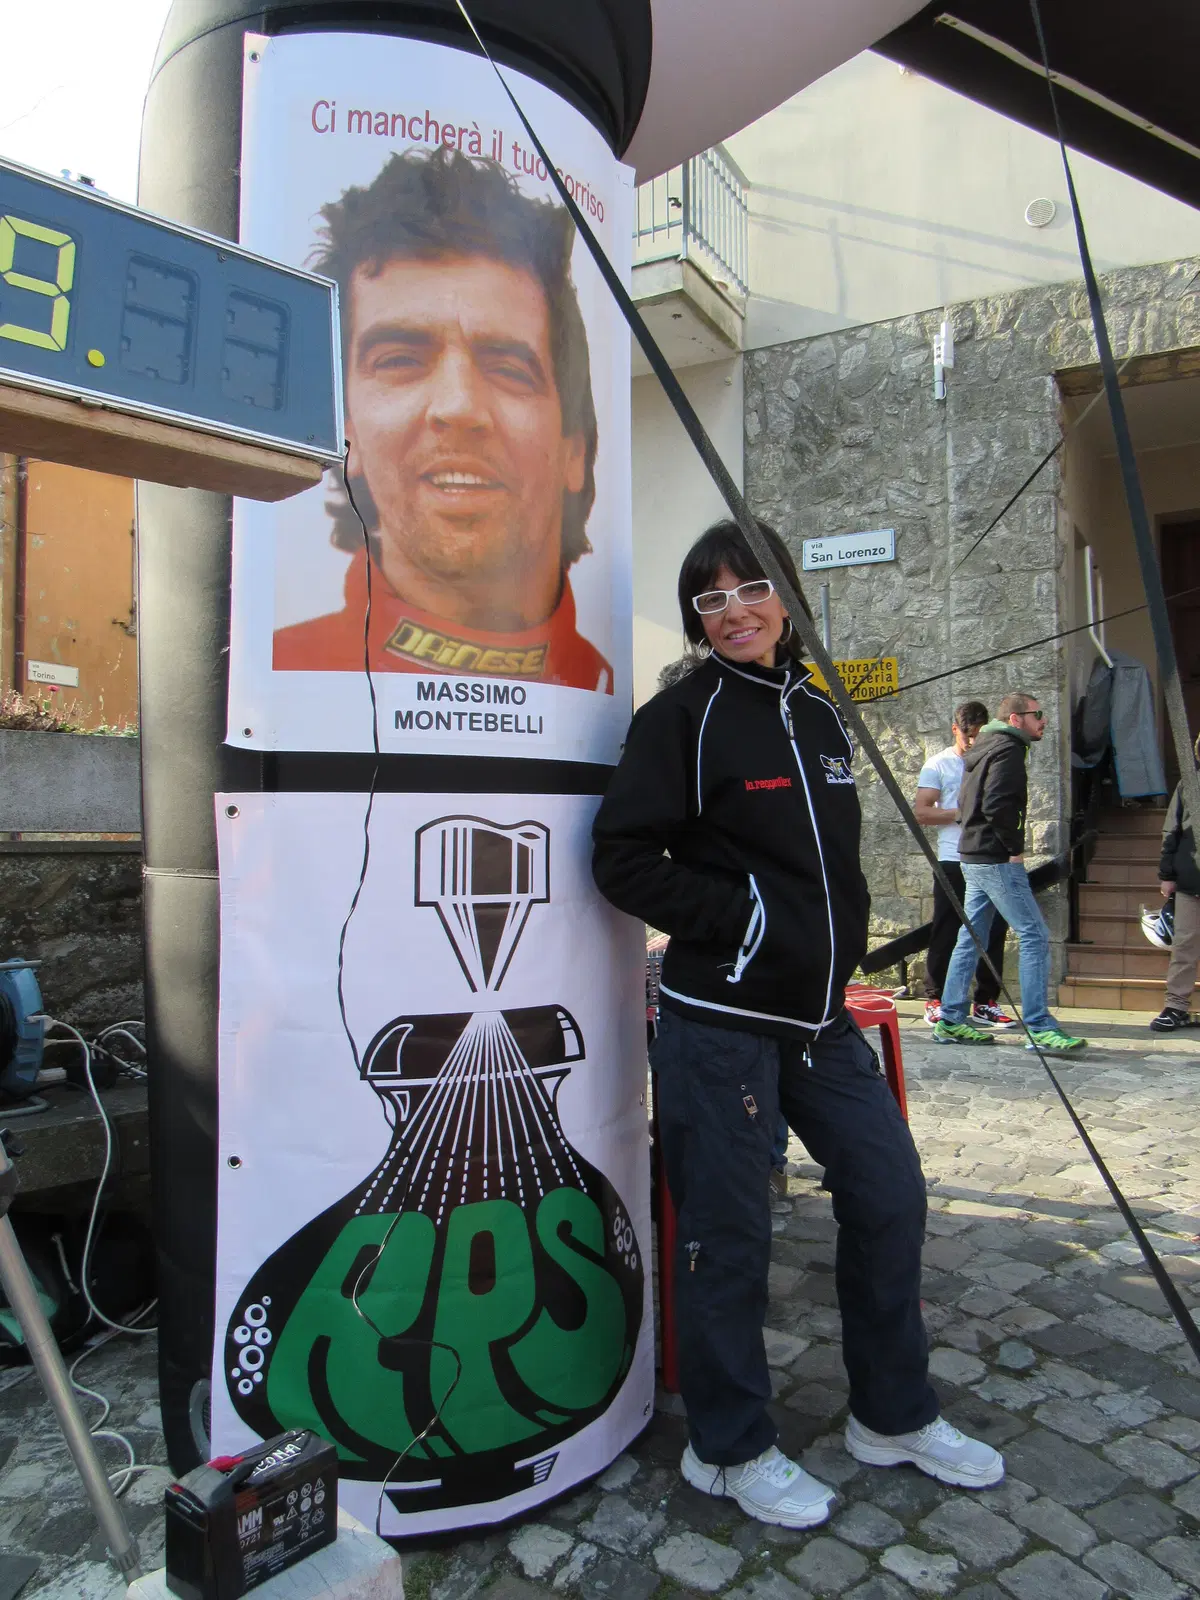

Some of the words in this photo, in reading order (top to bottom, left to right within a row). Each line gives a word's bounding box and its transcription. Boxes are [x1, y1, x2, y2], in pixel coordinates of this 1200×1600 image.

[311, 99, 336, 134] Ci
[347, 109, 482, 155] mancherà
[491, 128, 503, 162] il
[511, 140, 548, 182] tuo
[811, 541, 823, 550] via
[810, 552, 833, 563] San
[838, 547, 886, 560] Lorenzo
[32, 670, 56, 680] Torino
[834, 661, 893, 673] storante
[416, 680, 527, 706] MASSIMO
[394, 710, 543, 735] MONTEBELLI
